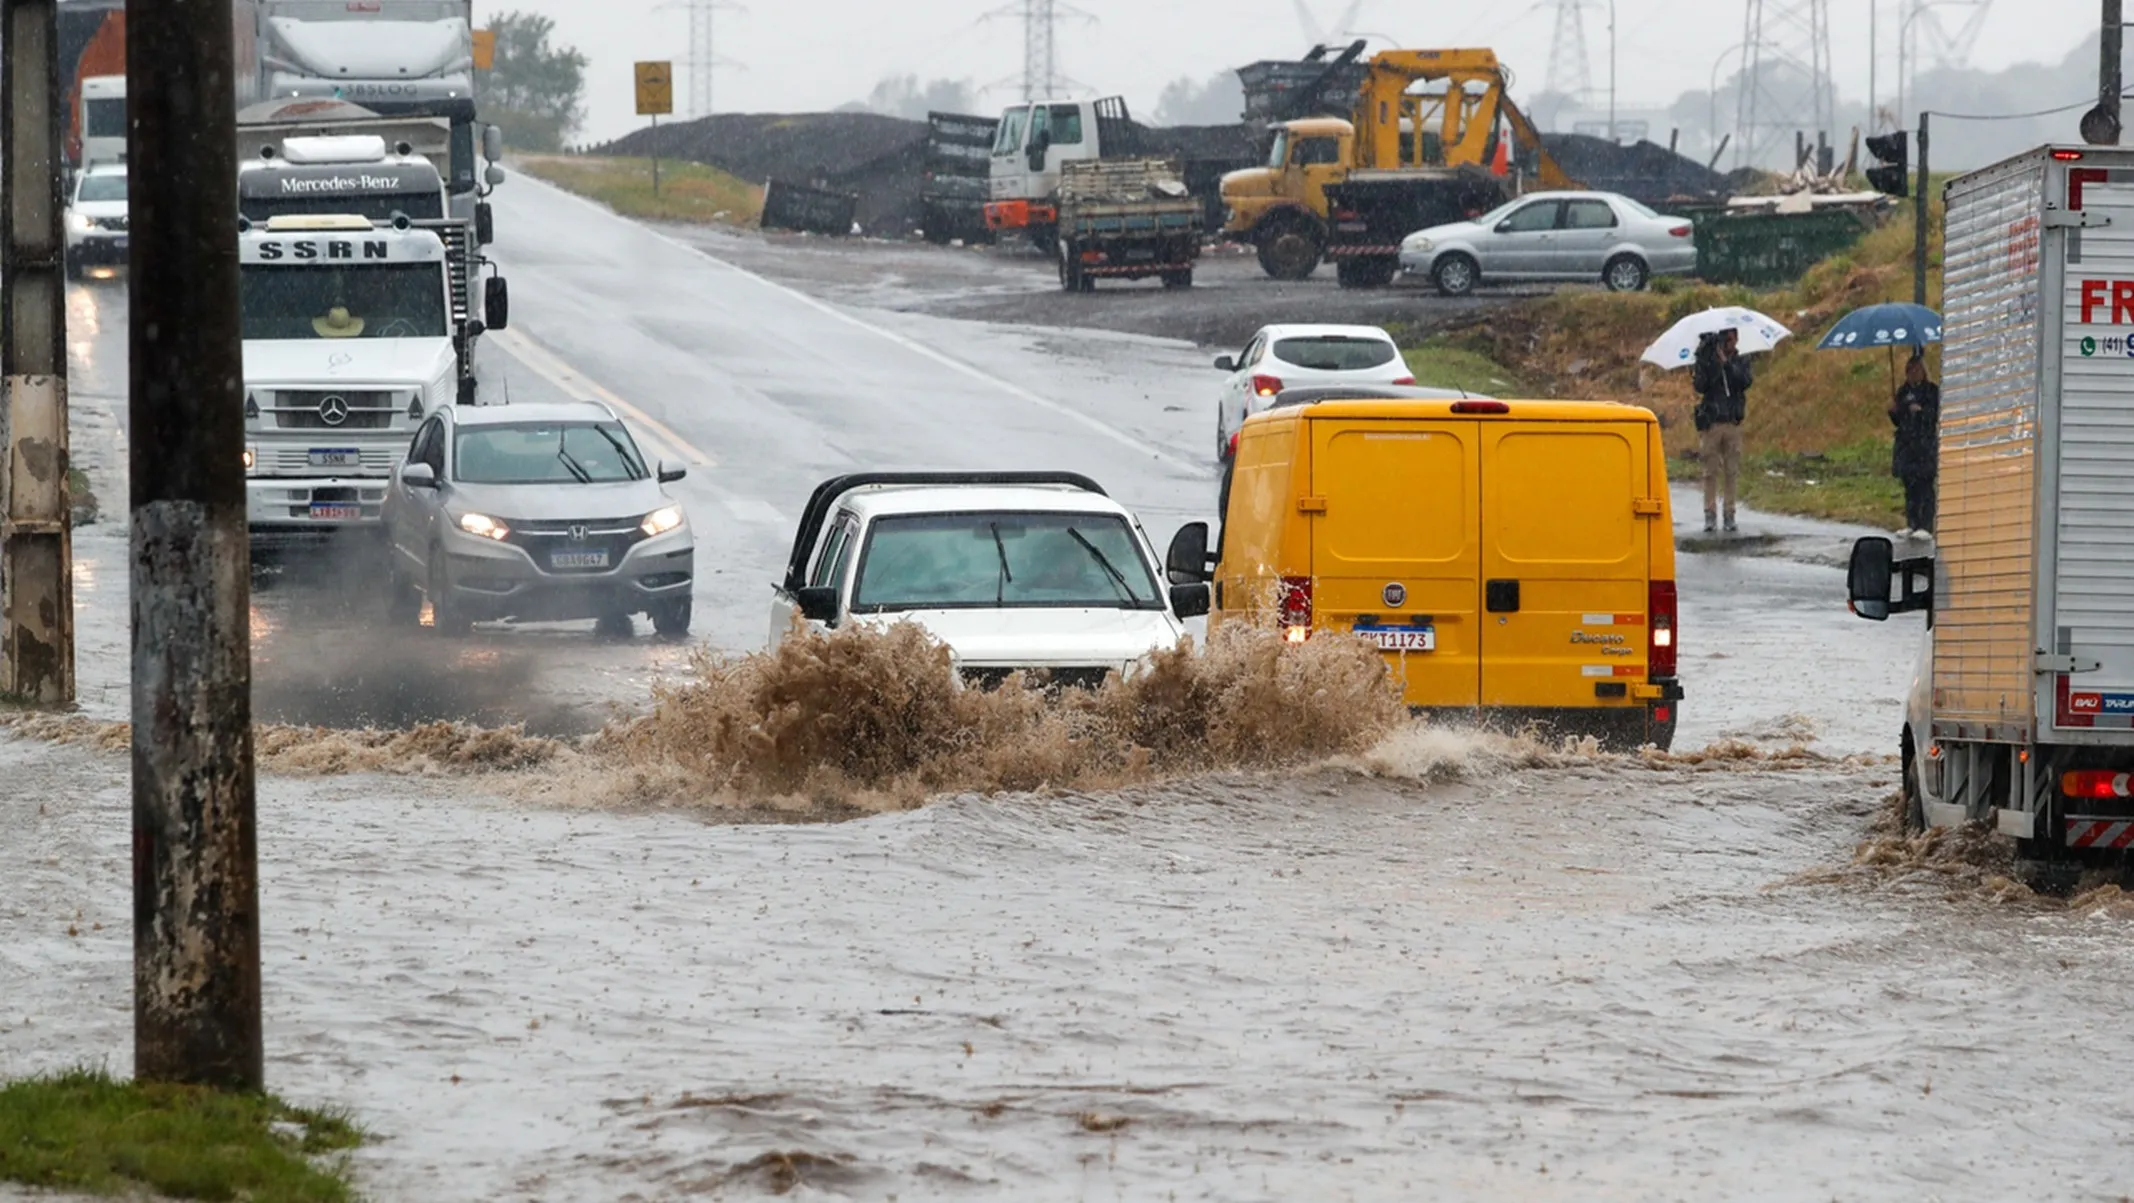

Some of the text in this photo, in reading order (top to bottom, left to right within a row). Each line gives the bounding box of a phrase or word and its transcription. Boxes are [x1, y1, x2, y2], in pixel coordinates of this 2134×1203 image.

[281, 174, 400, 193] Mercedes-Benz
[259, 241, 388, 260] SSRN
[2081, 280, 2134, 324] FR
[2102, 337, 2123, 355] (41)
[1569, 630, 1624, 644] Ducato
[2105, 699, 2134, 709] TARU
